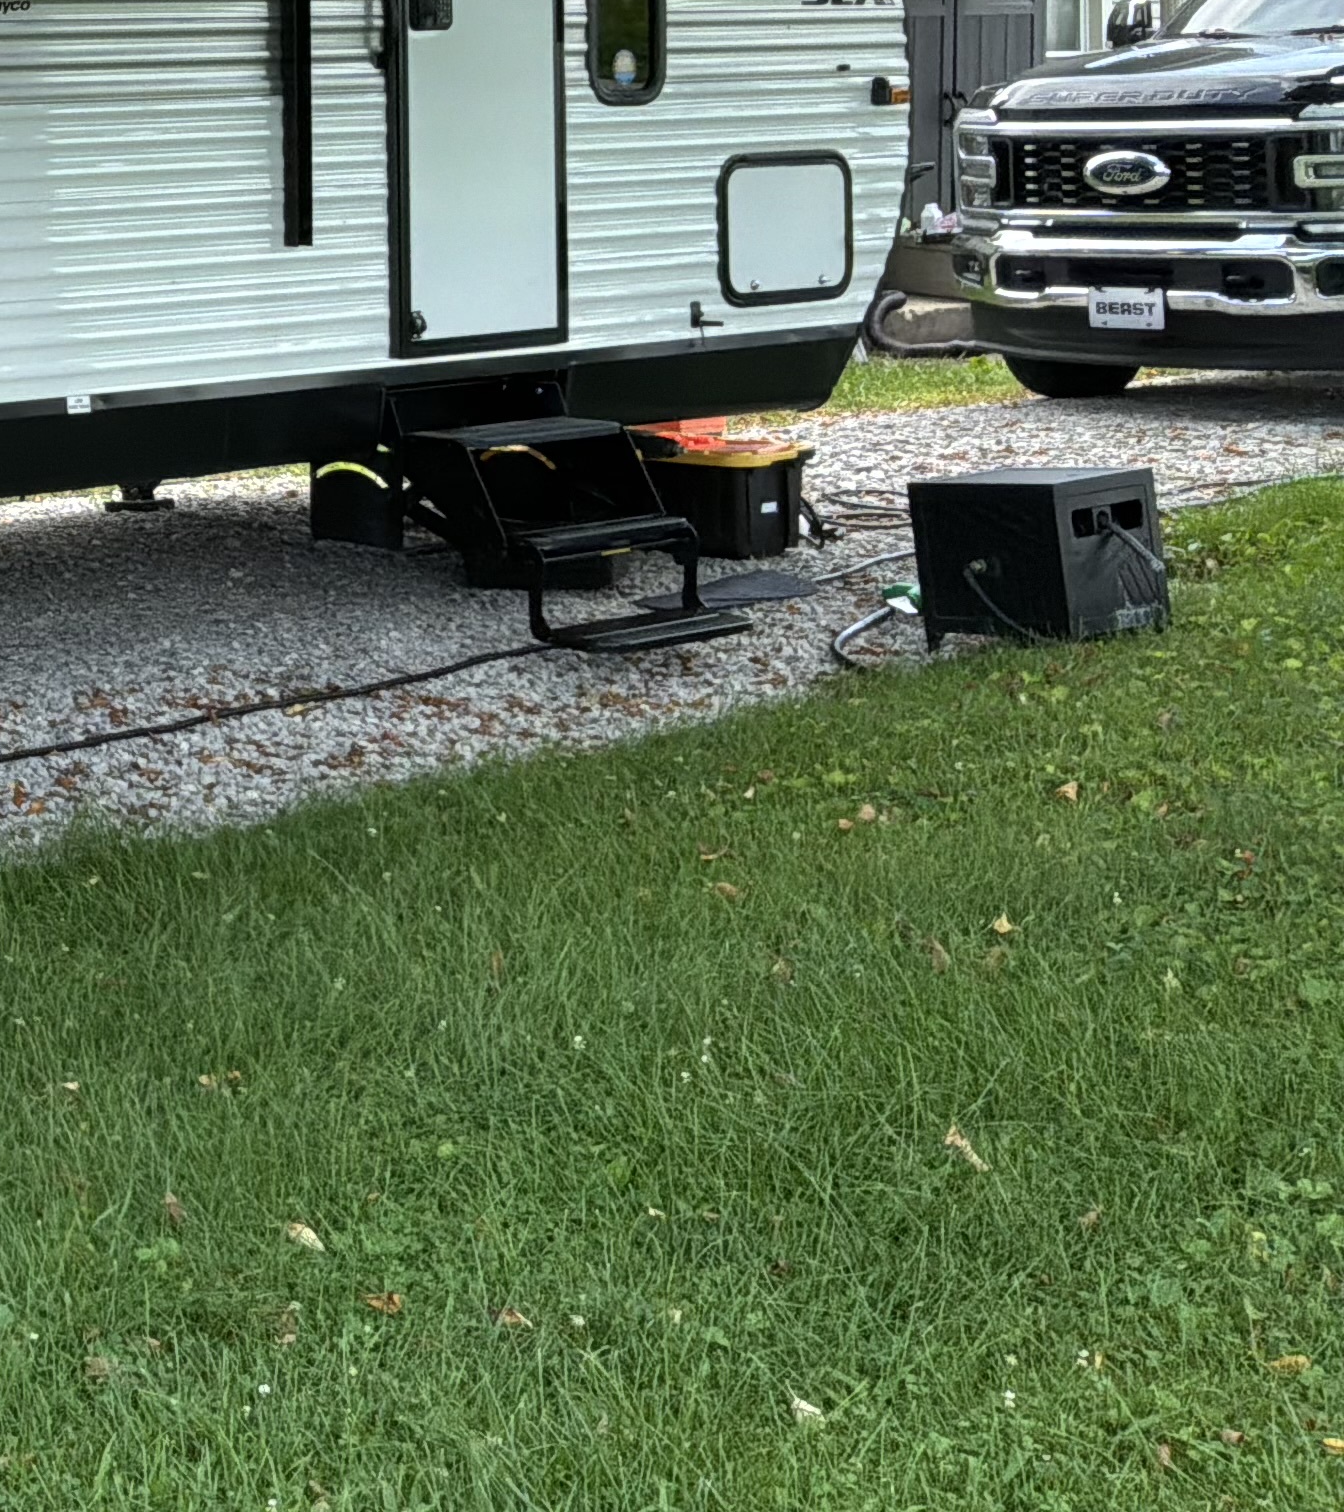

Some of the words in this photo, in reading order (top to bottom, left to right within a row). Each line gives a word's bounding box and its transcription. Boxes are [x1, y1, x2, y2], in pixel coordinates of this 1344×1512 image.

[1016, 90, 1143, 106] SUPER
[1150, 87, 1258, 103] DUTY
[1102, 163, 1142, 183] Ford
[1095, 300, 1156, 317] BEAST
